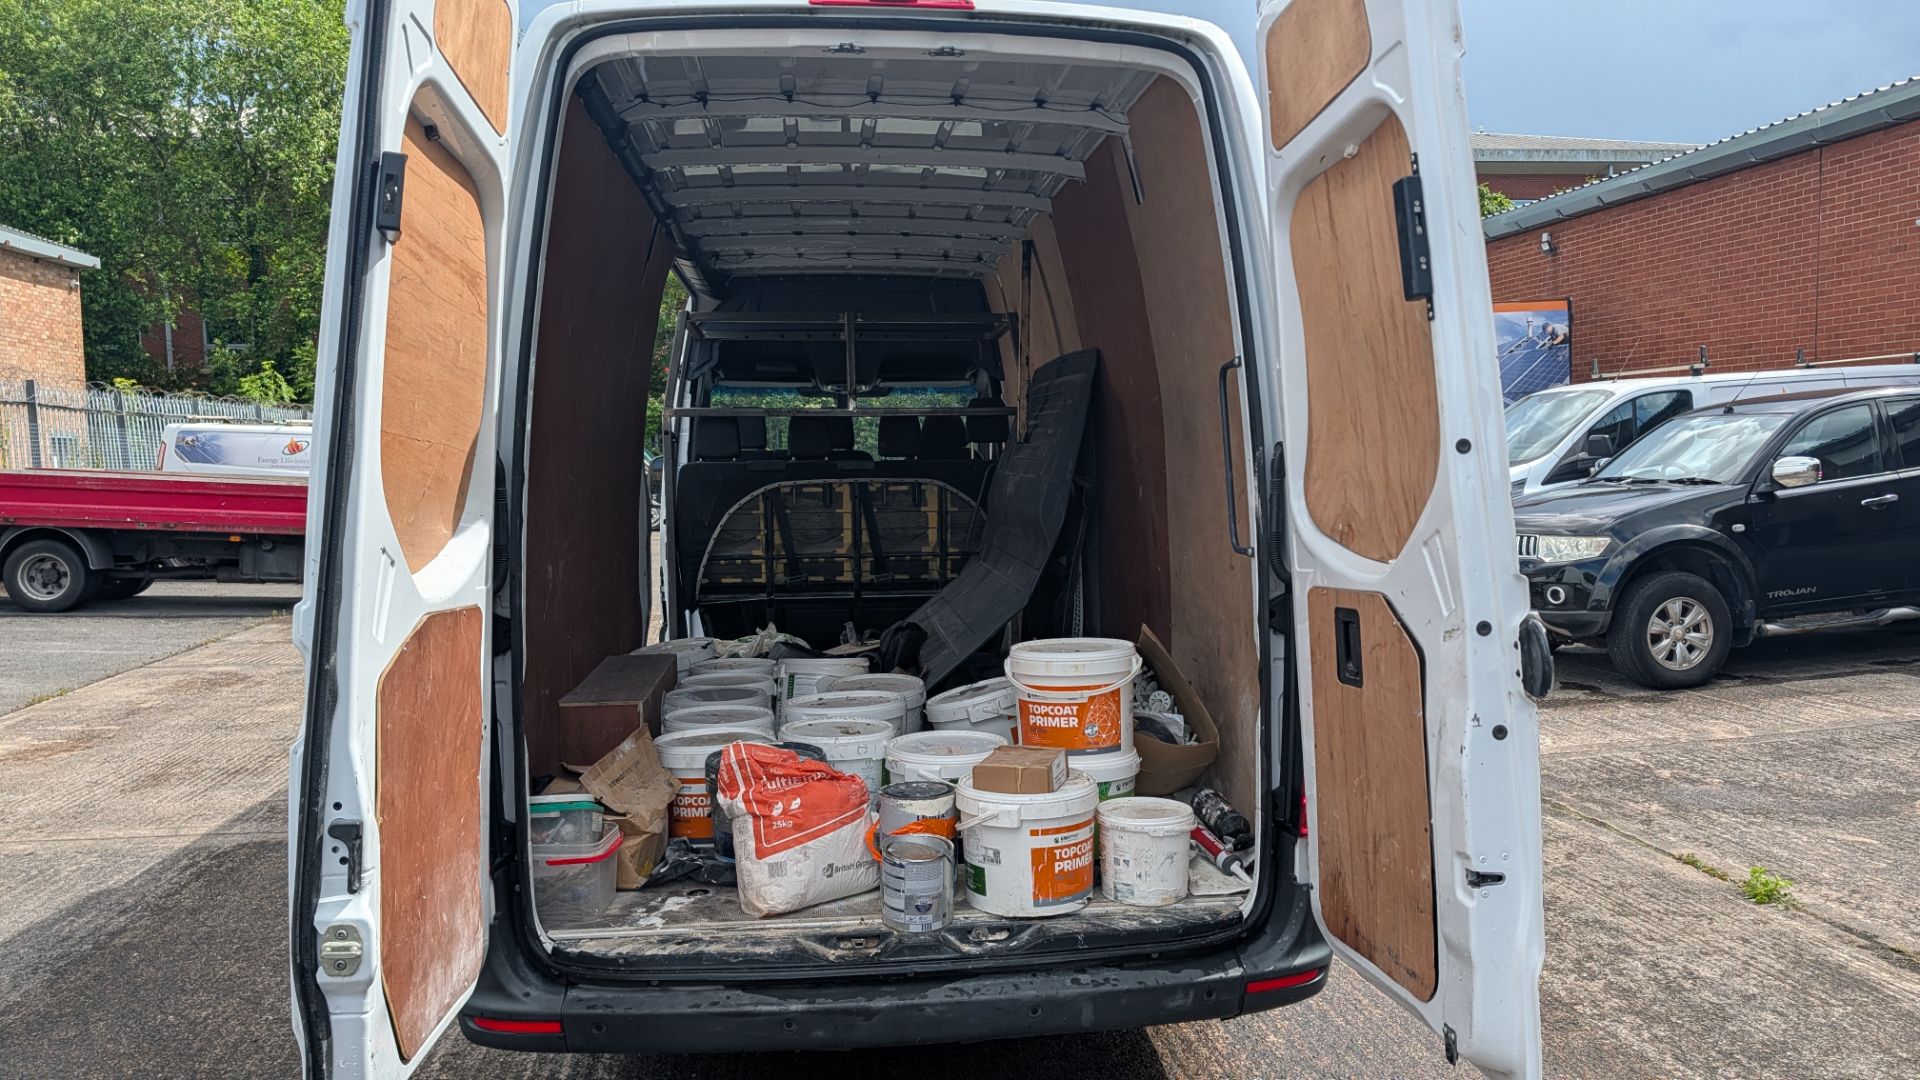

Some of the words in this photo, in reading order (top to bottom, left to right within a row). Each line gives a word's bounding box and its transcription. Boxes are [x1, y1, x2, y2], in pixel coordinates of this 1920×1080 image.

[1766, 586, 1816, 598] TROJAN
[1028, 704, 1079, 715] TOPCOAT
[1029, 715, 1079, 728] PRIMER
[772, 819, 793, 829] 25kg
